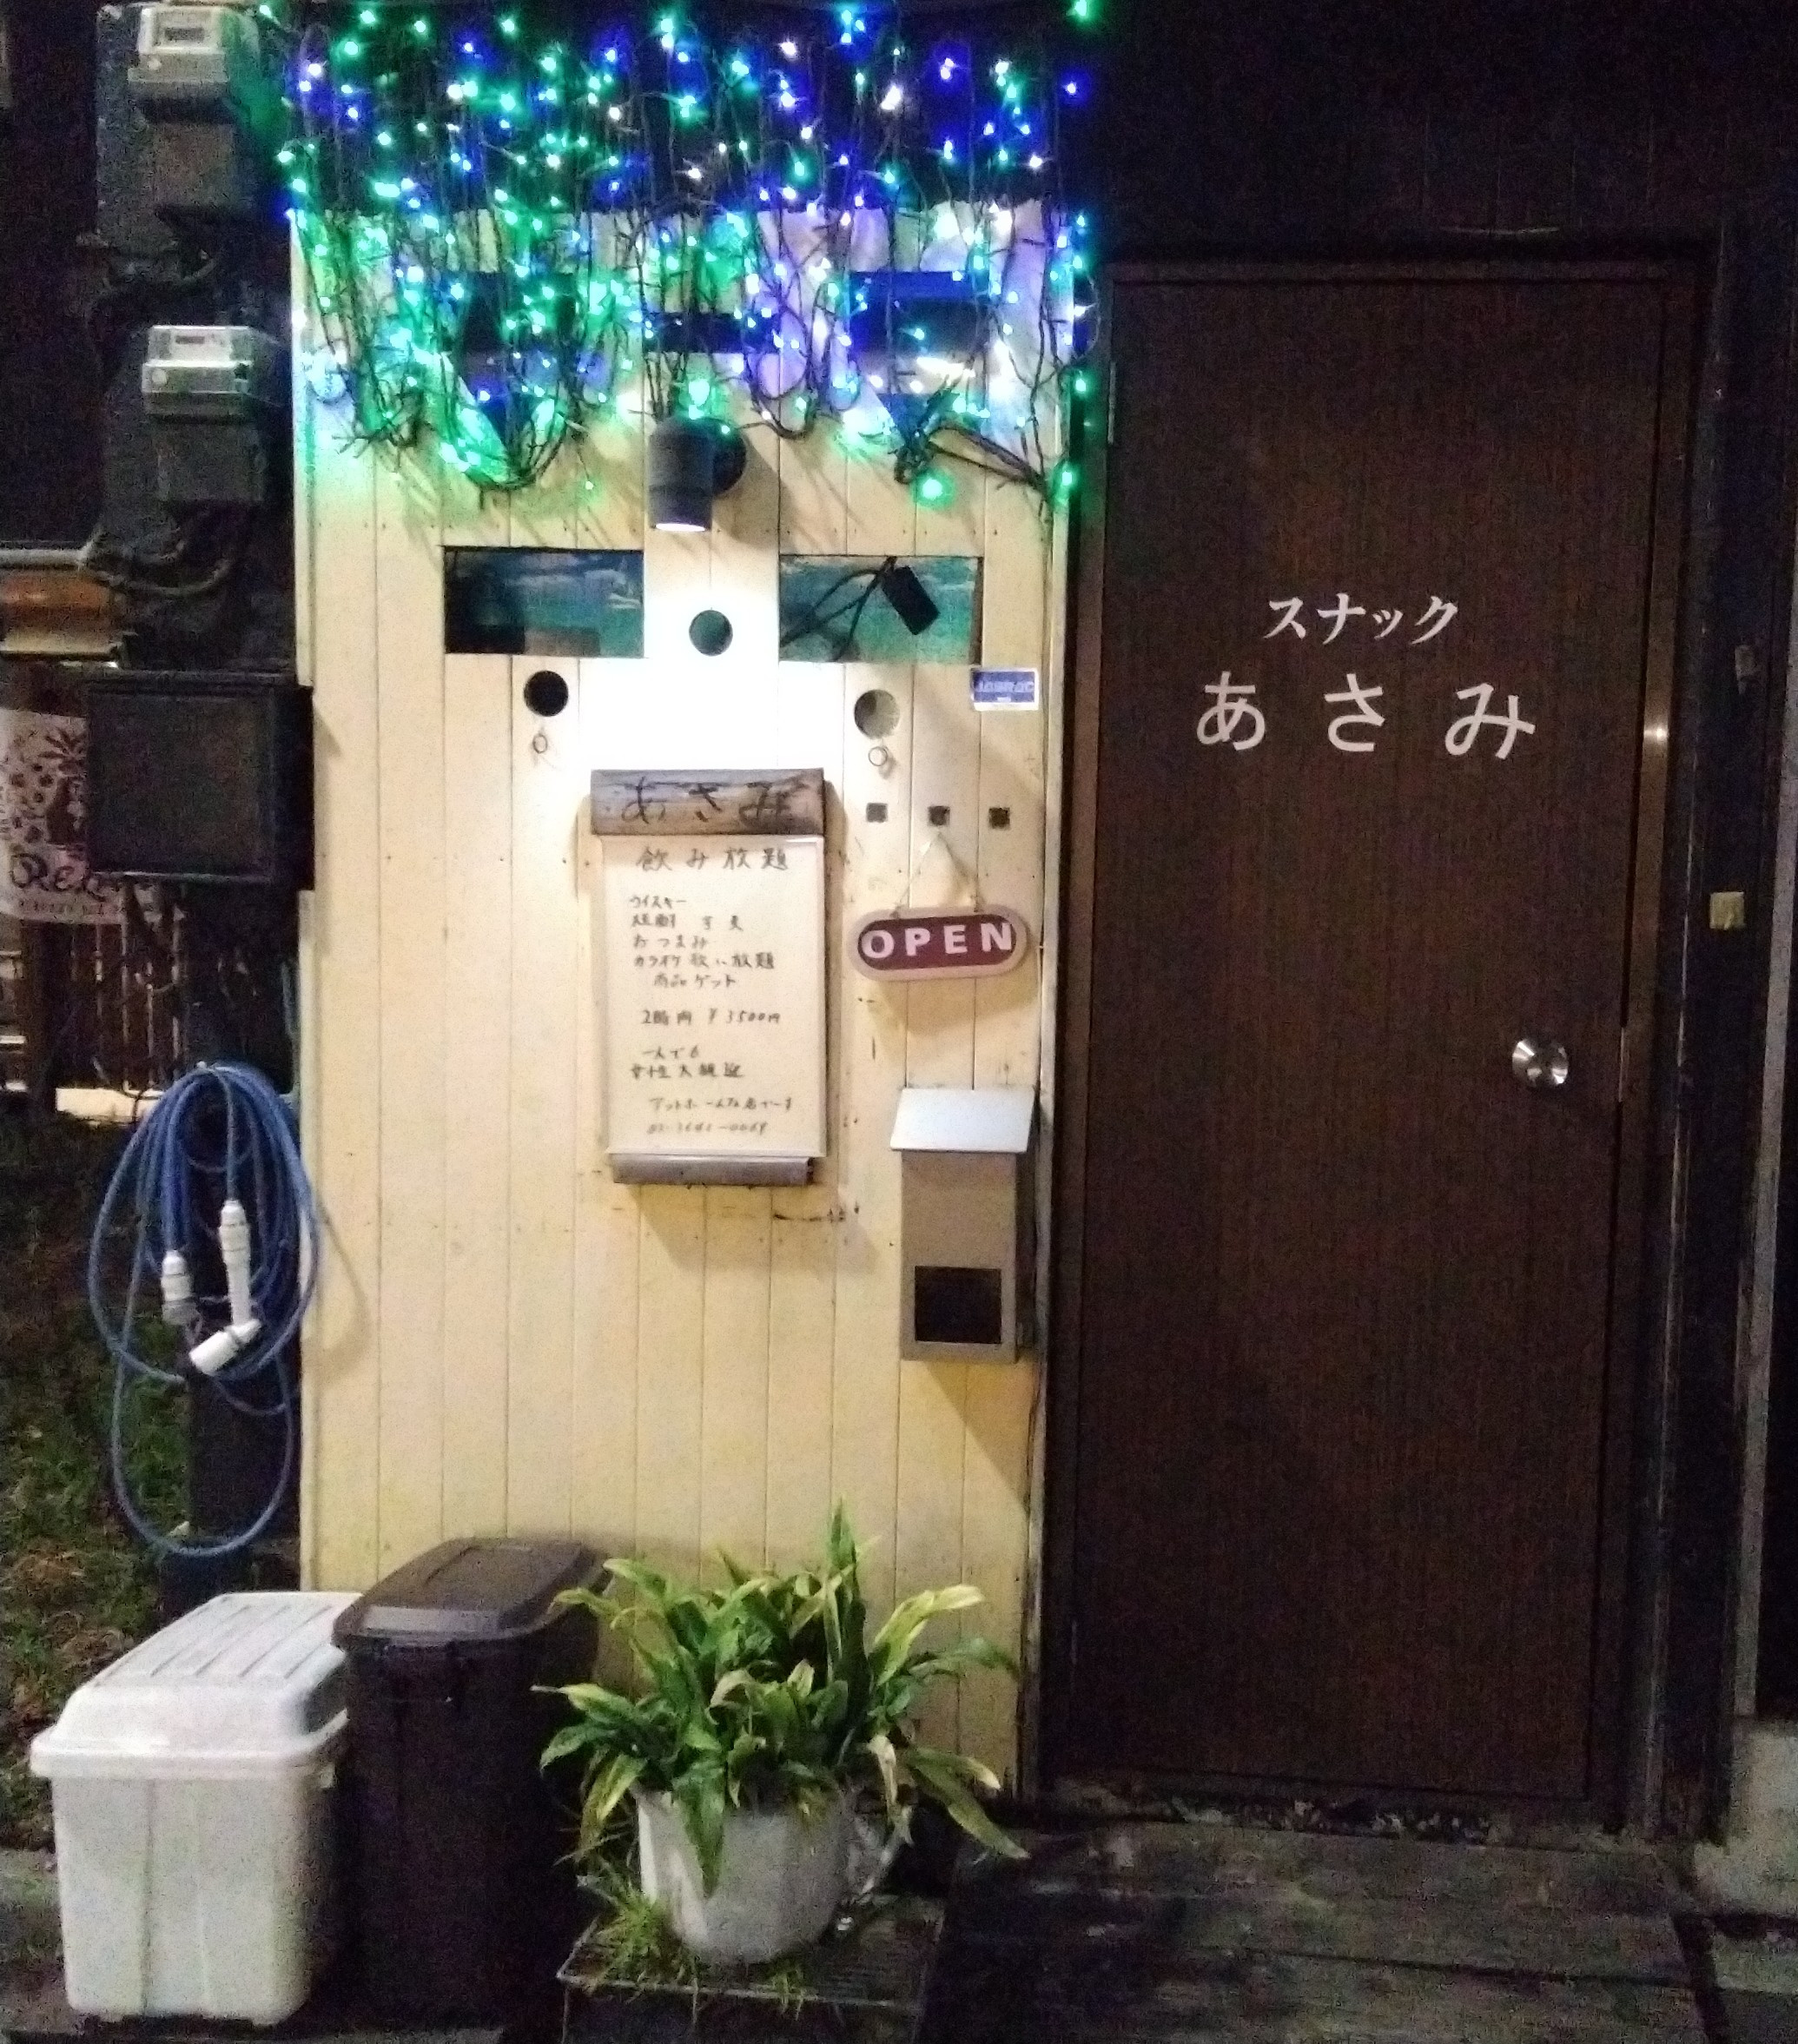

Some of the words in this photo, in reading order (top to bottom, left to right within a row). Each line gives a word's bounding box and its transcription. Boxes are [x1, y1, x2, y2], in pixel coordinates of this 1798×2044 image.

[1263, 592, 1458, 645] スナック
[1196, 671, 1536, 759] あさみ
[636, 845, 788, 870] 飲み放題
[861, 922, 1013, 960] OPEN
